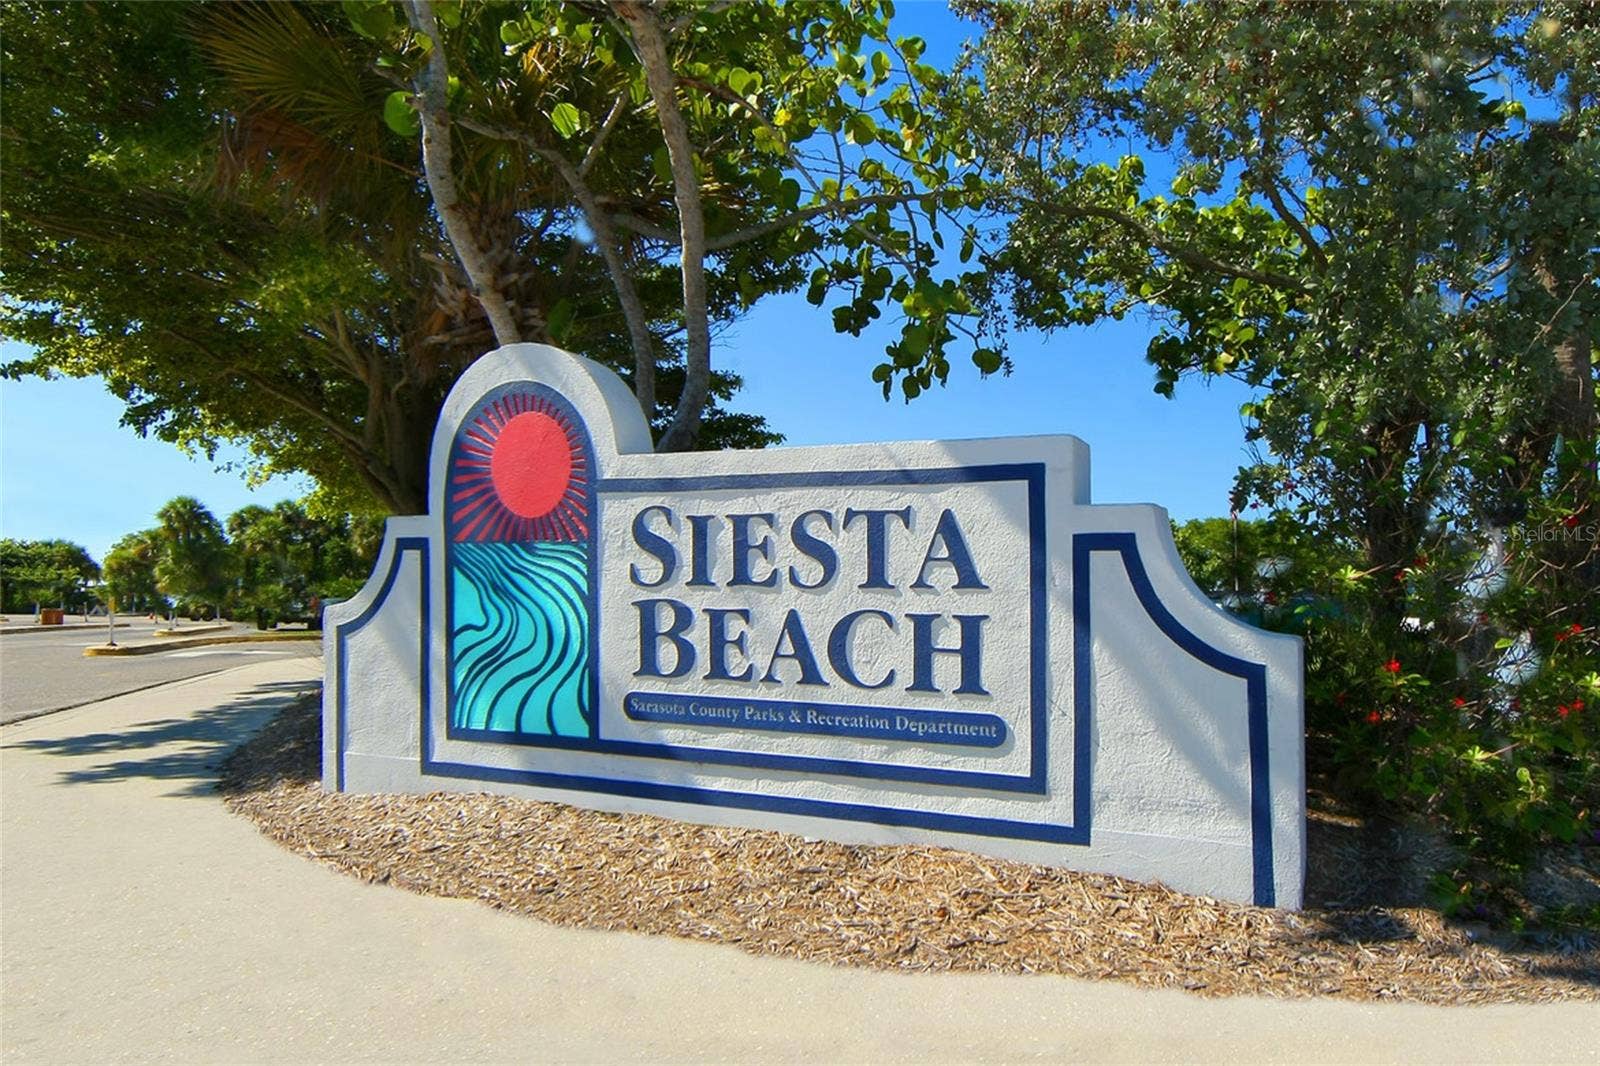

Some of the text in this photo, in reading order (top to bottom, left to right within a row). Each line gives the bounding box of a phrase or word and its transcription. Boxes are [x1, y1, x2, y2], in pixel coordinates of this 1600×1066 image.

[630, 505, 990, 590] SIESTA
[631, 598, 990, 695] BEACH
[630, 698, 997, 737] Sarasota County Parks & Recreation Department
